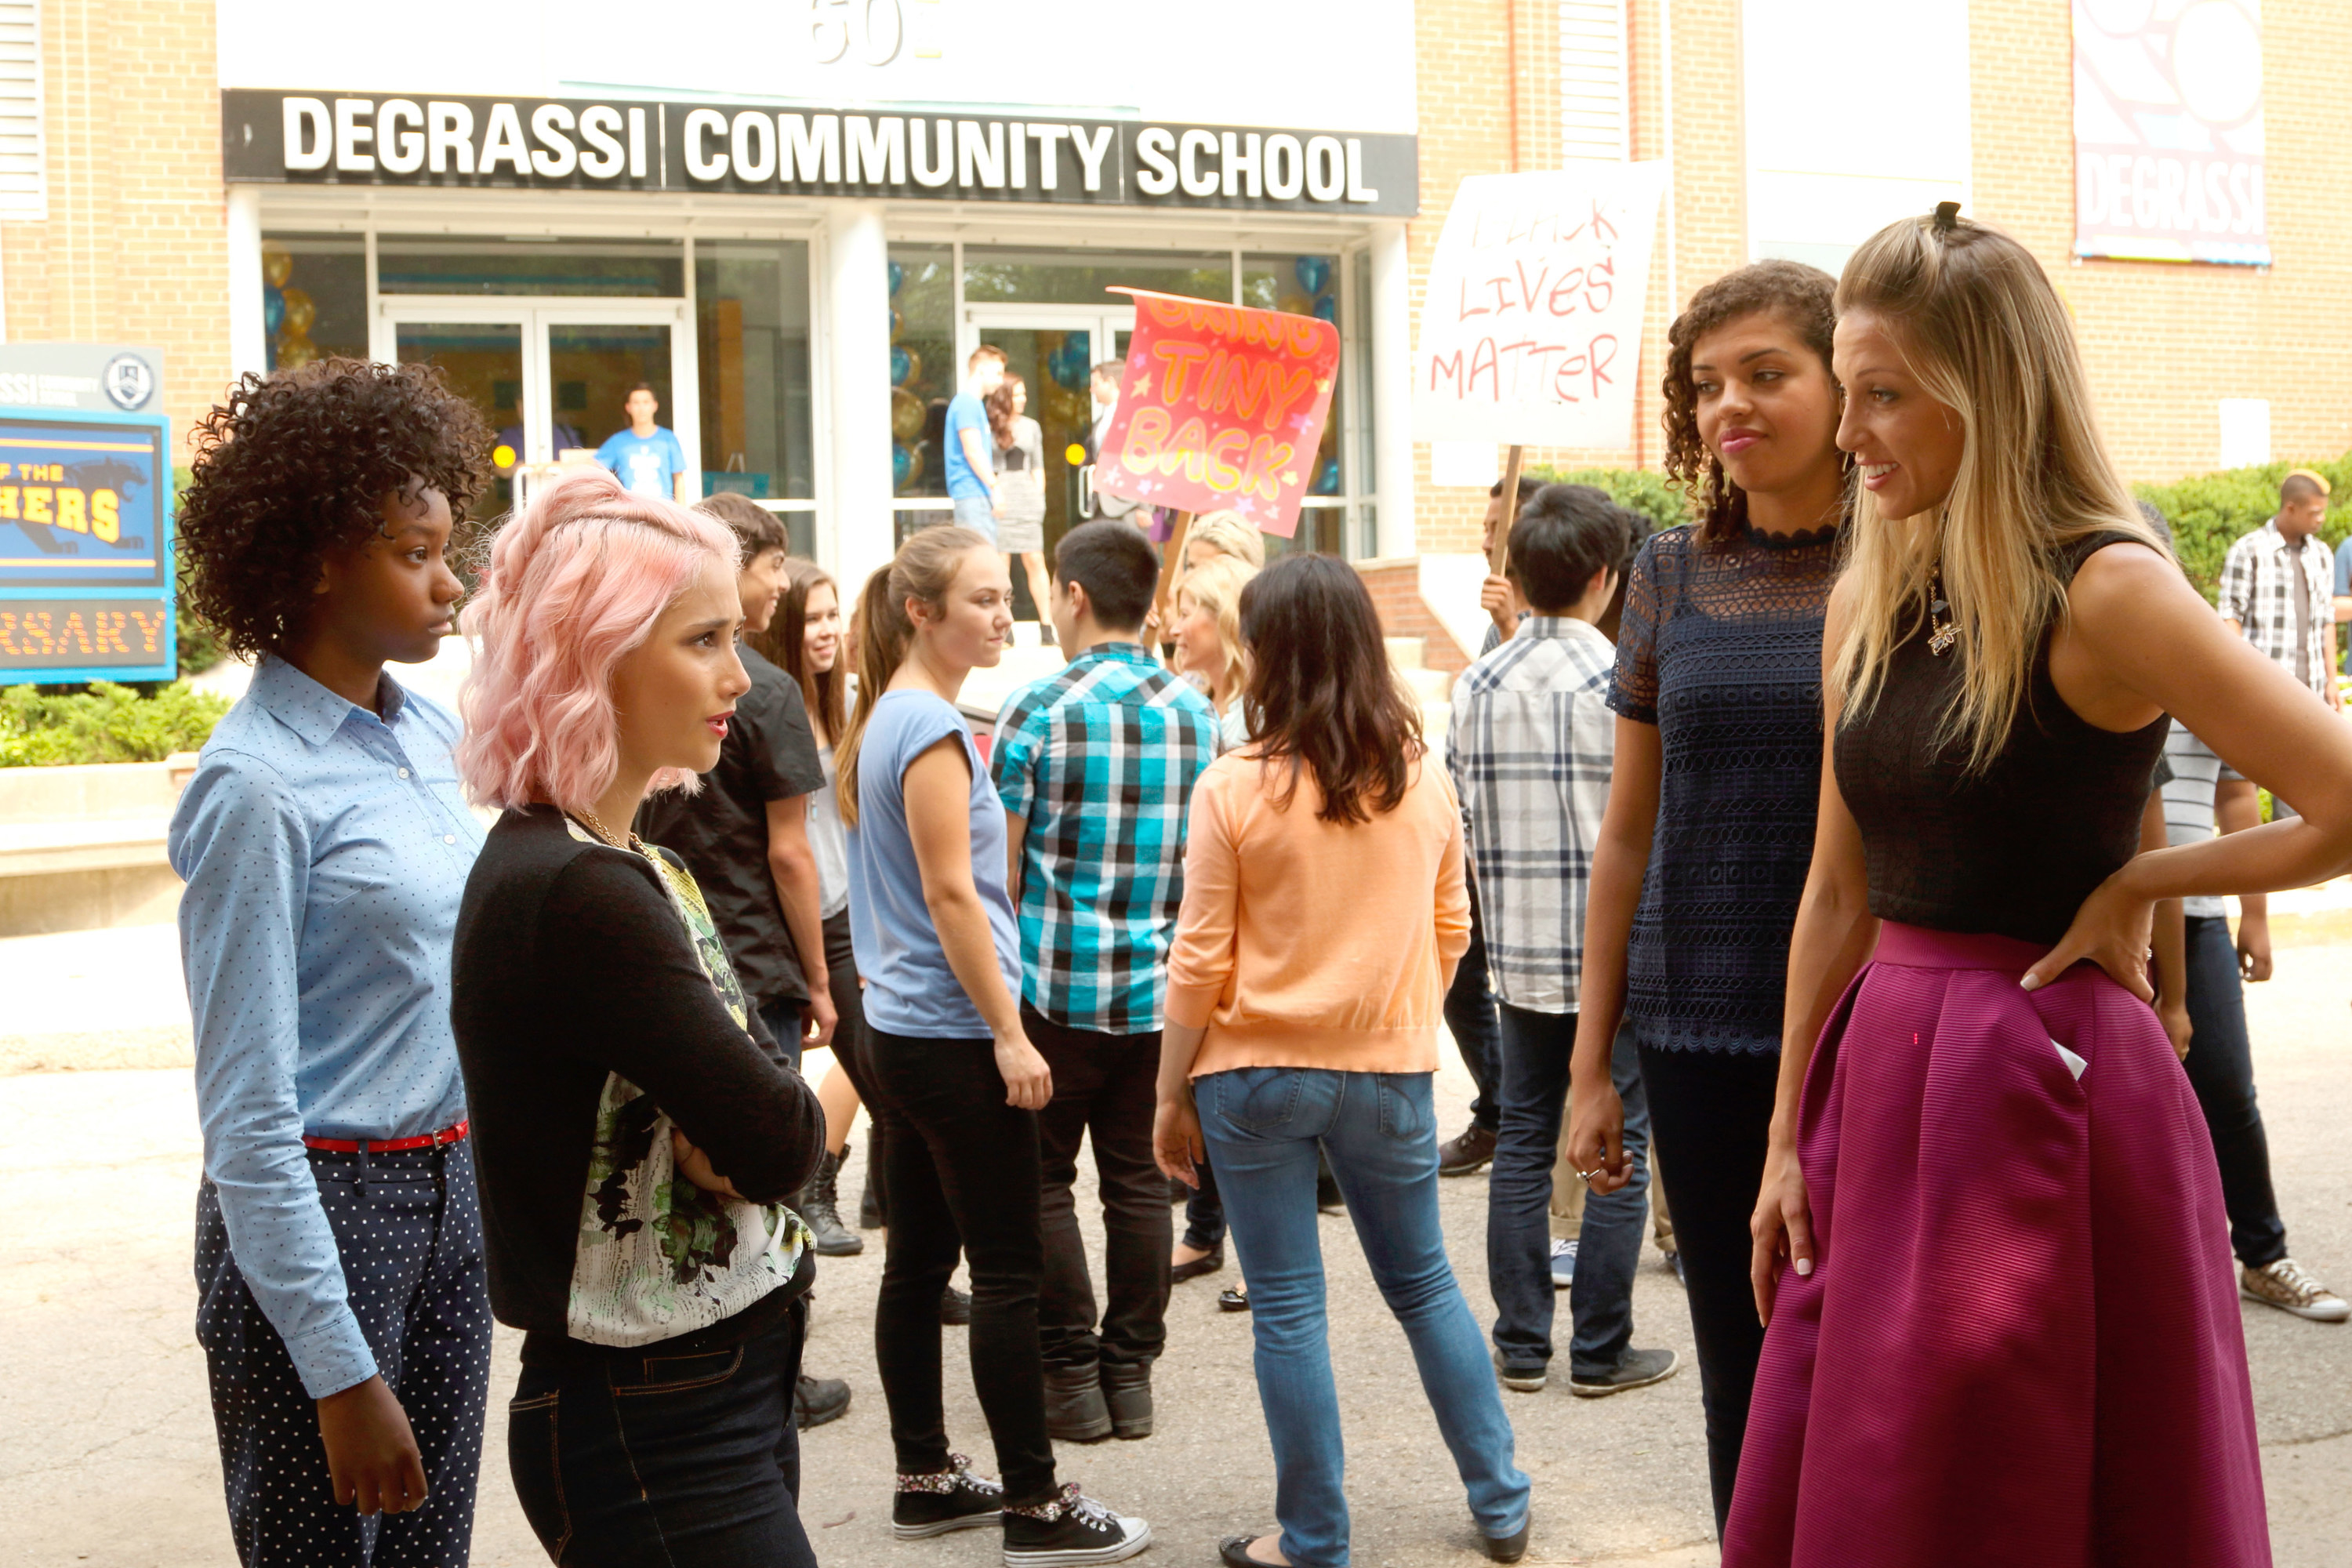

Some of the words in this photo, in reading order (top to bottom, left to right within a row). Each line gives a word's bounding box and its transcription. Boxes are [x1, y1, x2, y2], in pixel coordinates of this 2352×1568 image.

[282, 96, 648, 179] DEGRASSI
[684, 108, 1114, 191] COMMUNITY
[1136, 127, 1379, 202] SCHOOL
[2078, 151, 2264, 235] DEGRASSI
[1152, 340, 1313, 430] TINY
[17, 463, 64, 482] THE
[1121, 406, 1294, 501] BACK
